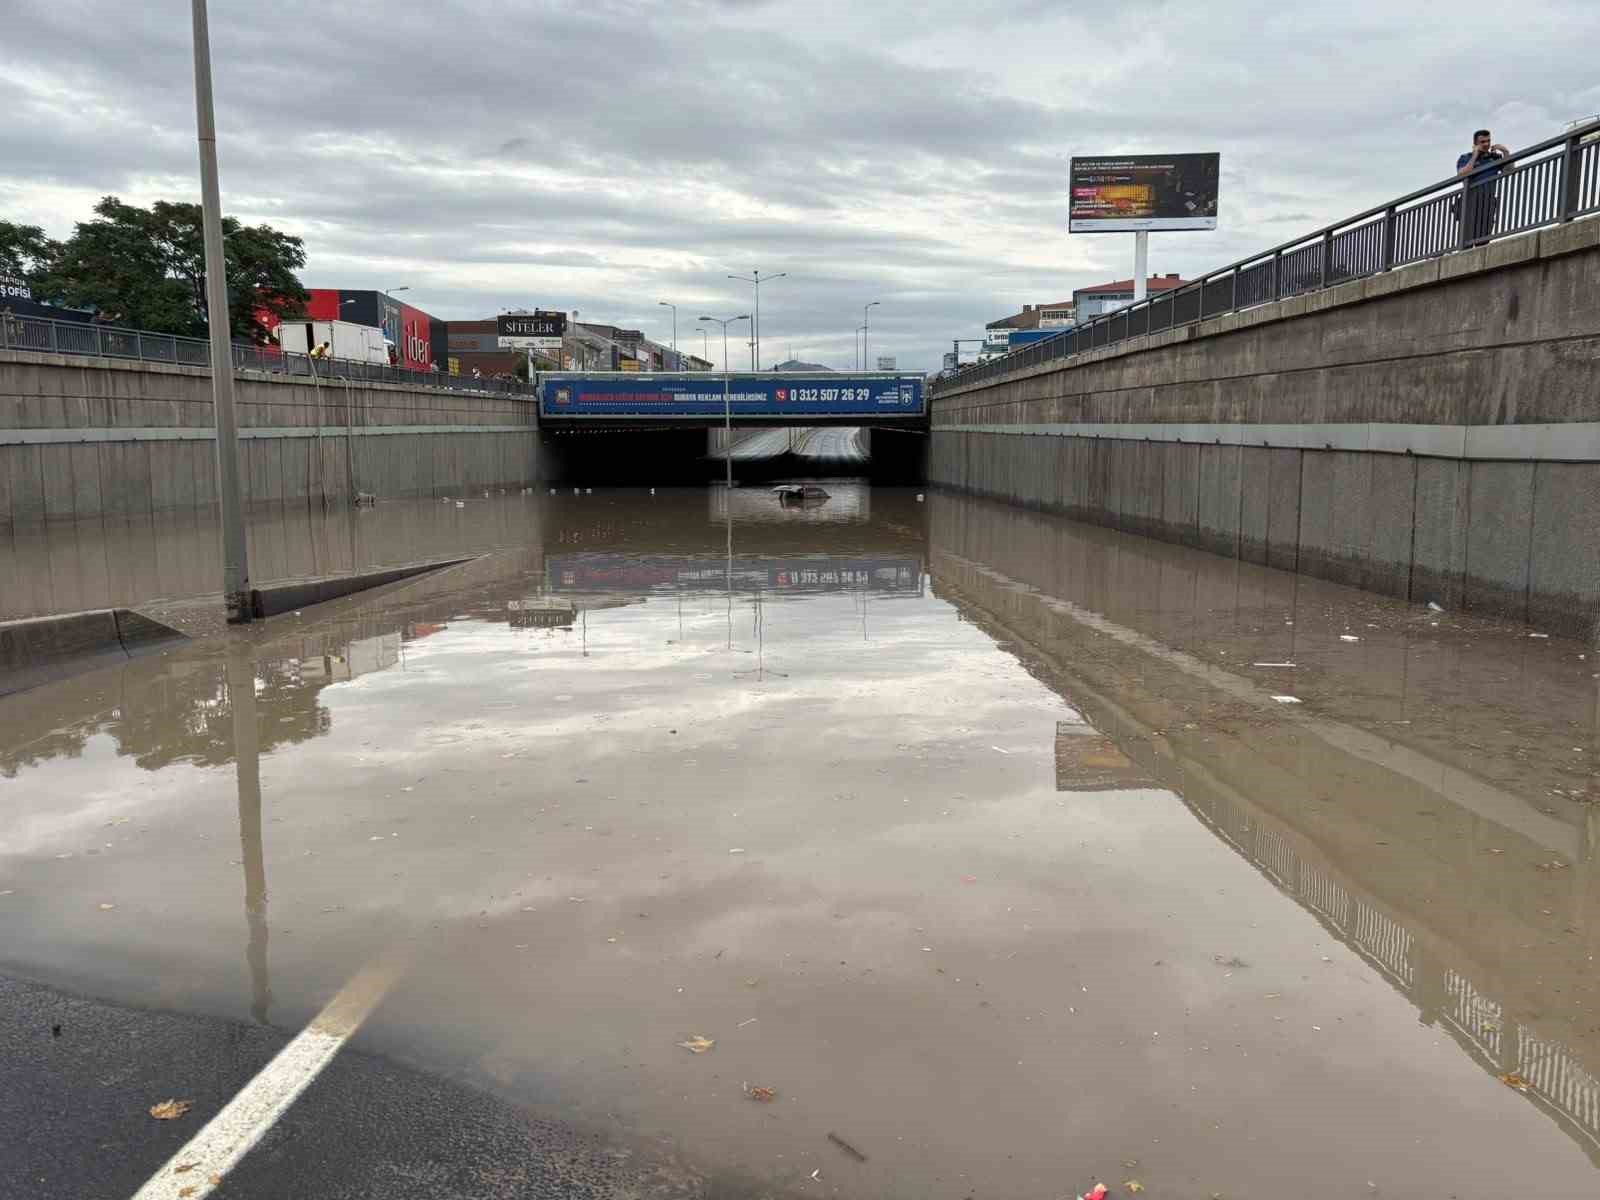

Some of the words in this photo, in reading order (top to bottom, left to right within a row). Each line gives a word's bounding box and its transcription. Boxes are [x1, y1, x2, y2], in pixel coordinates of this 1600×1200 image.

[8, 286, 31, 299] OFİSİ
[790, 389, 797, 401] 0
[799, 389, 818, 401] 312
[820, 389, 838, 401] 507
[841, 389, 854, 401] 26
[856, 389, 870, 401] 29
